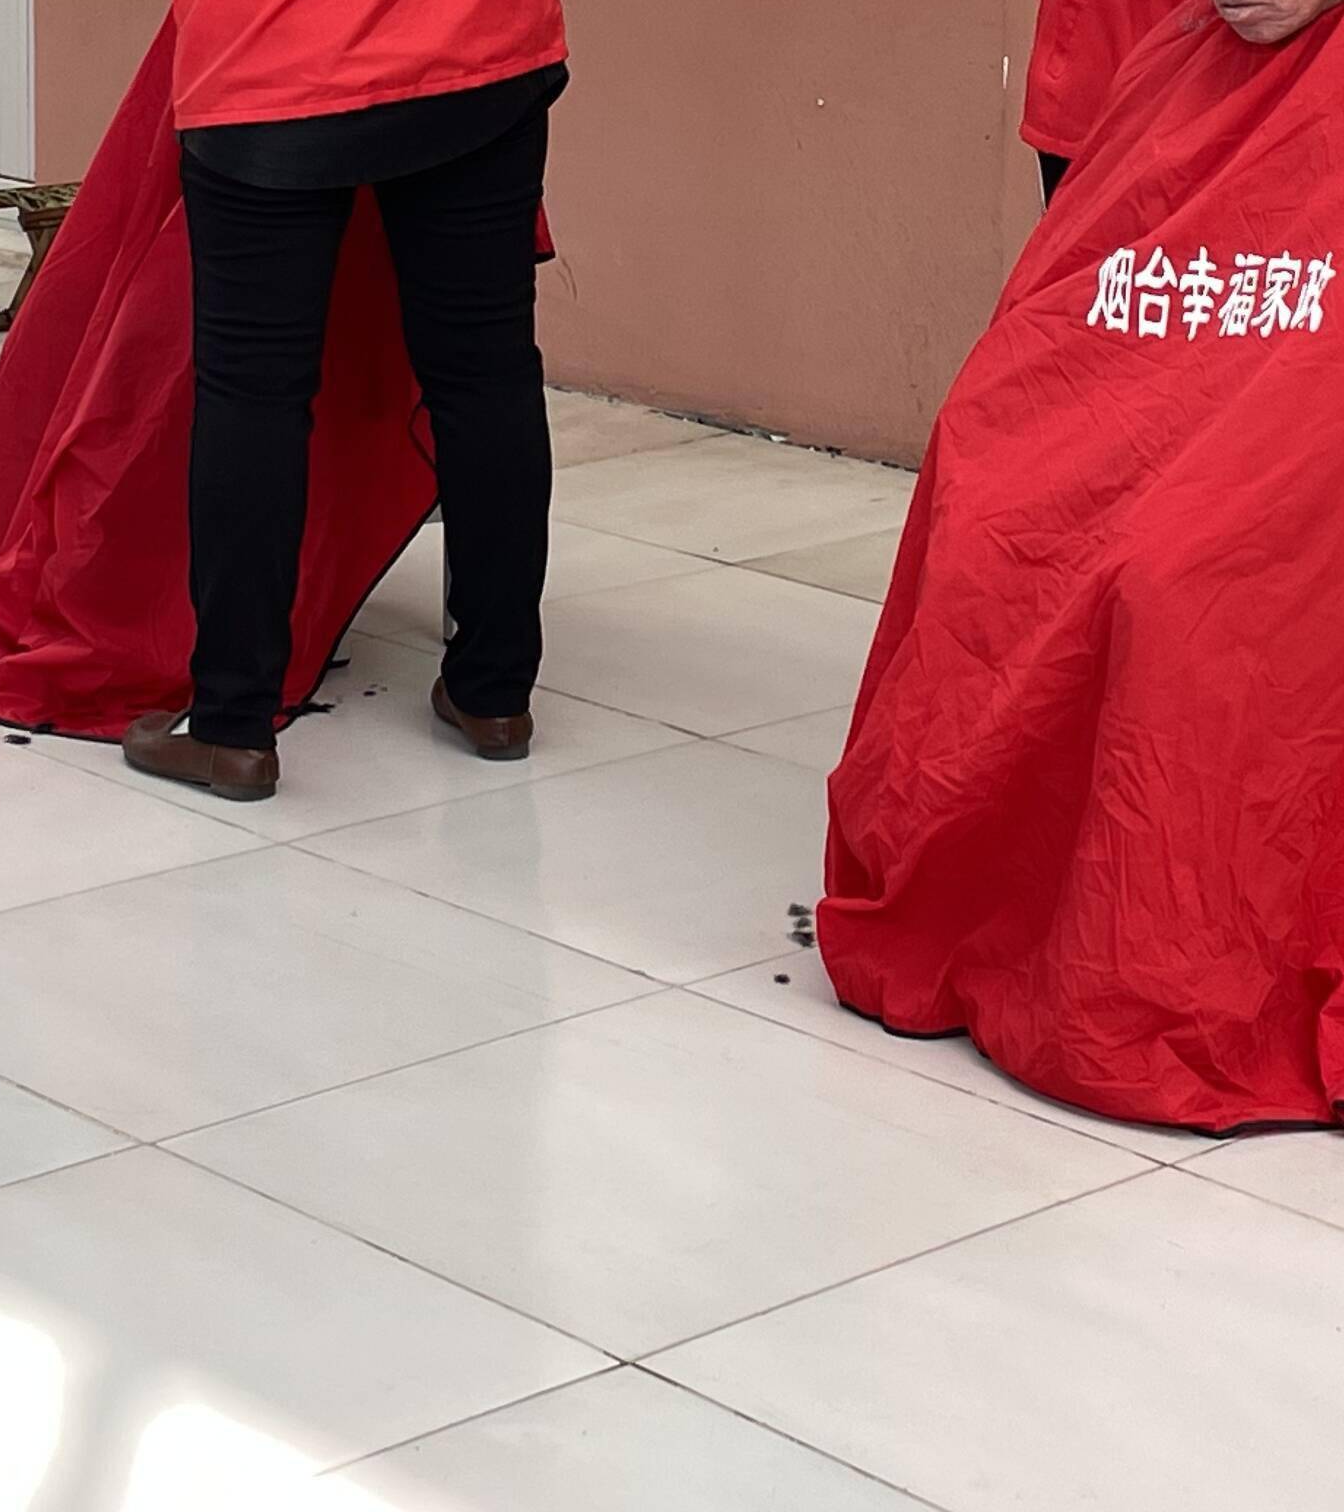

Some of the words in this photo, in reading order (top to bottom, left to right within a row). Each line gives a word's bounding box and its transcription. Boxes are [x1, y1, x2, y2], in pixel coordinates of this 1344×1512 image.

[1086, 245, 1337, 342] 烟台幸福家政
